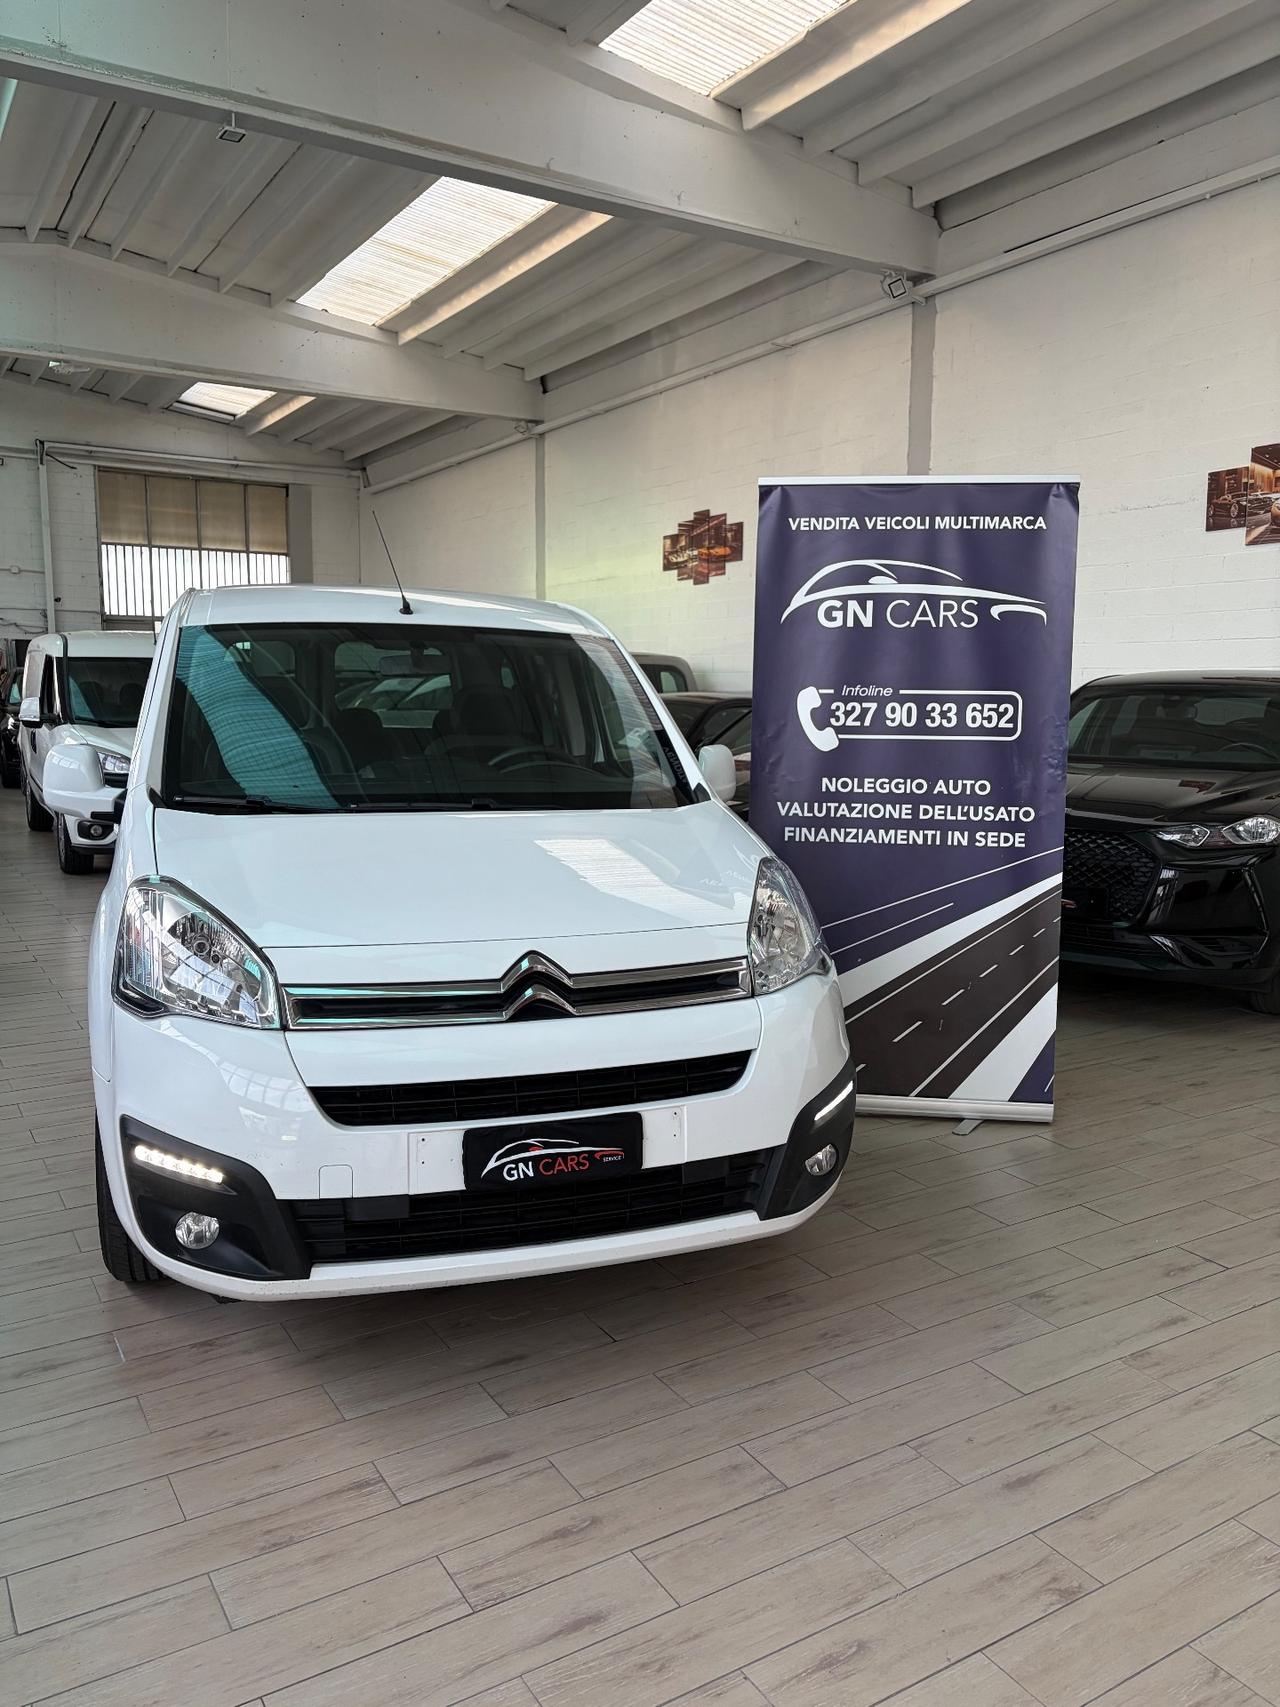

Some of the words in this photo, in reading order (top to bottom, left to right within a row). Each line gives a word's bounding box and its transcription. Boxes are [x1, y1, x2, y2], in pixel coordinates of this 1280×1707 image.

[788, 516, 860, 531] VENDITA
[864, 516, 930, 530] VEICOLI
[934, 515, 1047, 530] MULTIMARCA
[817, 599, 874, 628] GN
[886, 599, 979, 628] CARS
[841, 684, 893, 697] Infoline
[830, 701, 876, 727] 327
[885, 702, 918, 728] 90
[925, 702, 958, 728] 33
[965, 703, 1014, 729] 652
[821, 777, 928, 795] NOLEGGIO
[933, 779, 991, 796] AUTO
[776, 801, 913, 819] VALUTAZIONE
[919, 805, 1036, 822] DELL'USATO
[784, 827, 941, 846] FINANZIAMENTI
[947, 830, 969, 846] IN
[974, 831, 1026, 848] SEDE
[503, 1162, 534, 1181] GN
[539, 1153, 590, 1176] CARS
